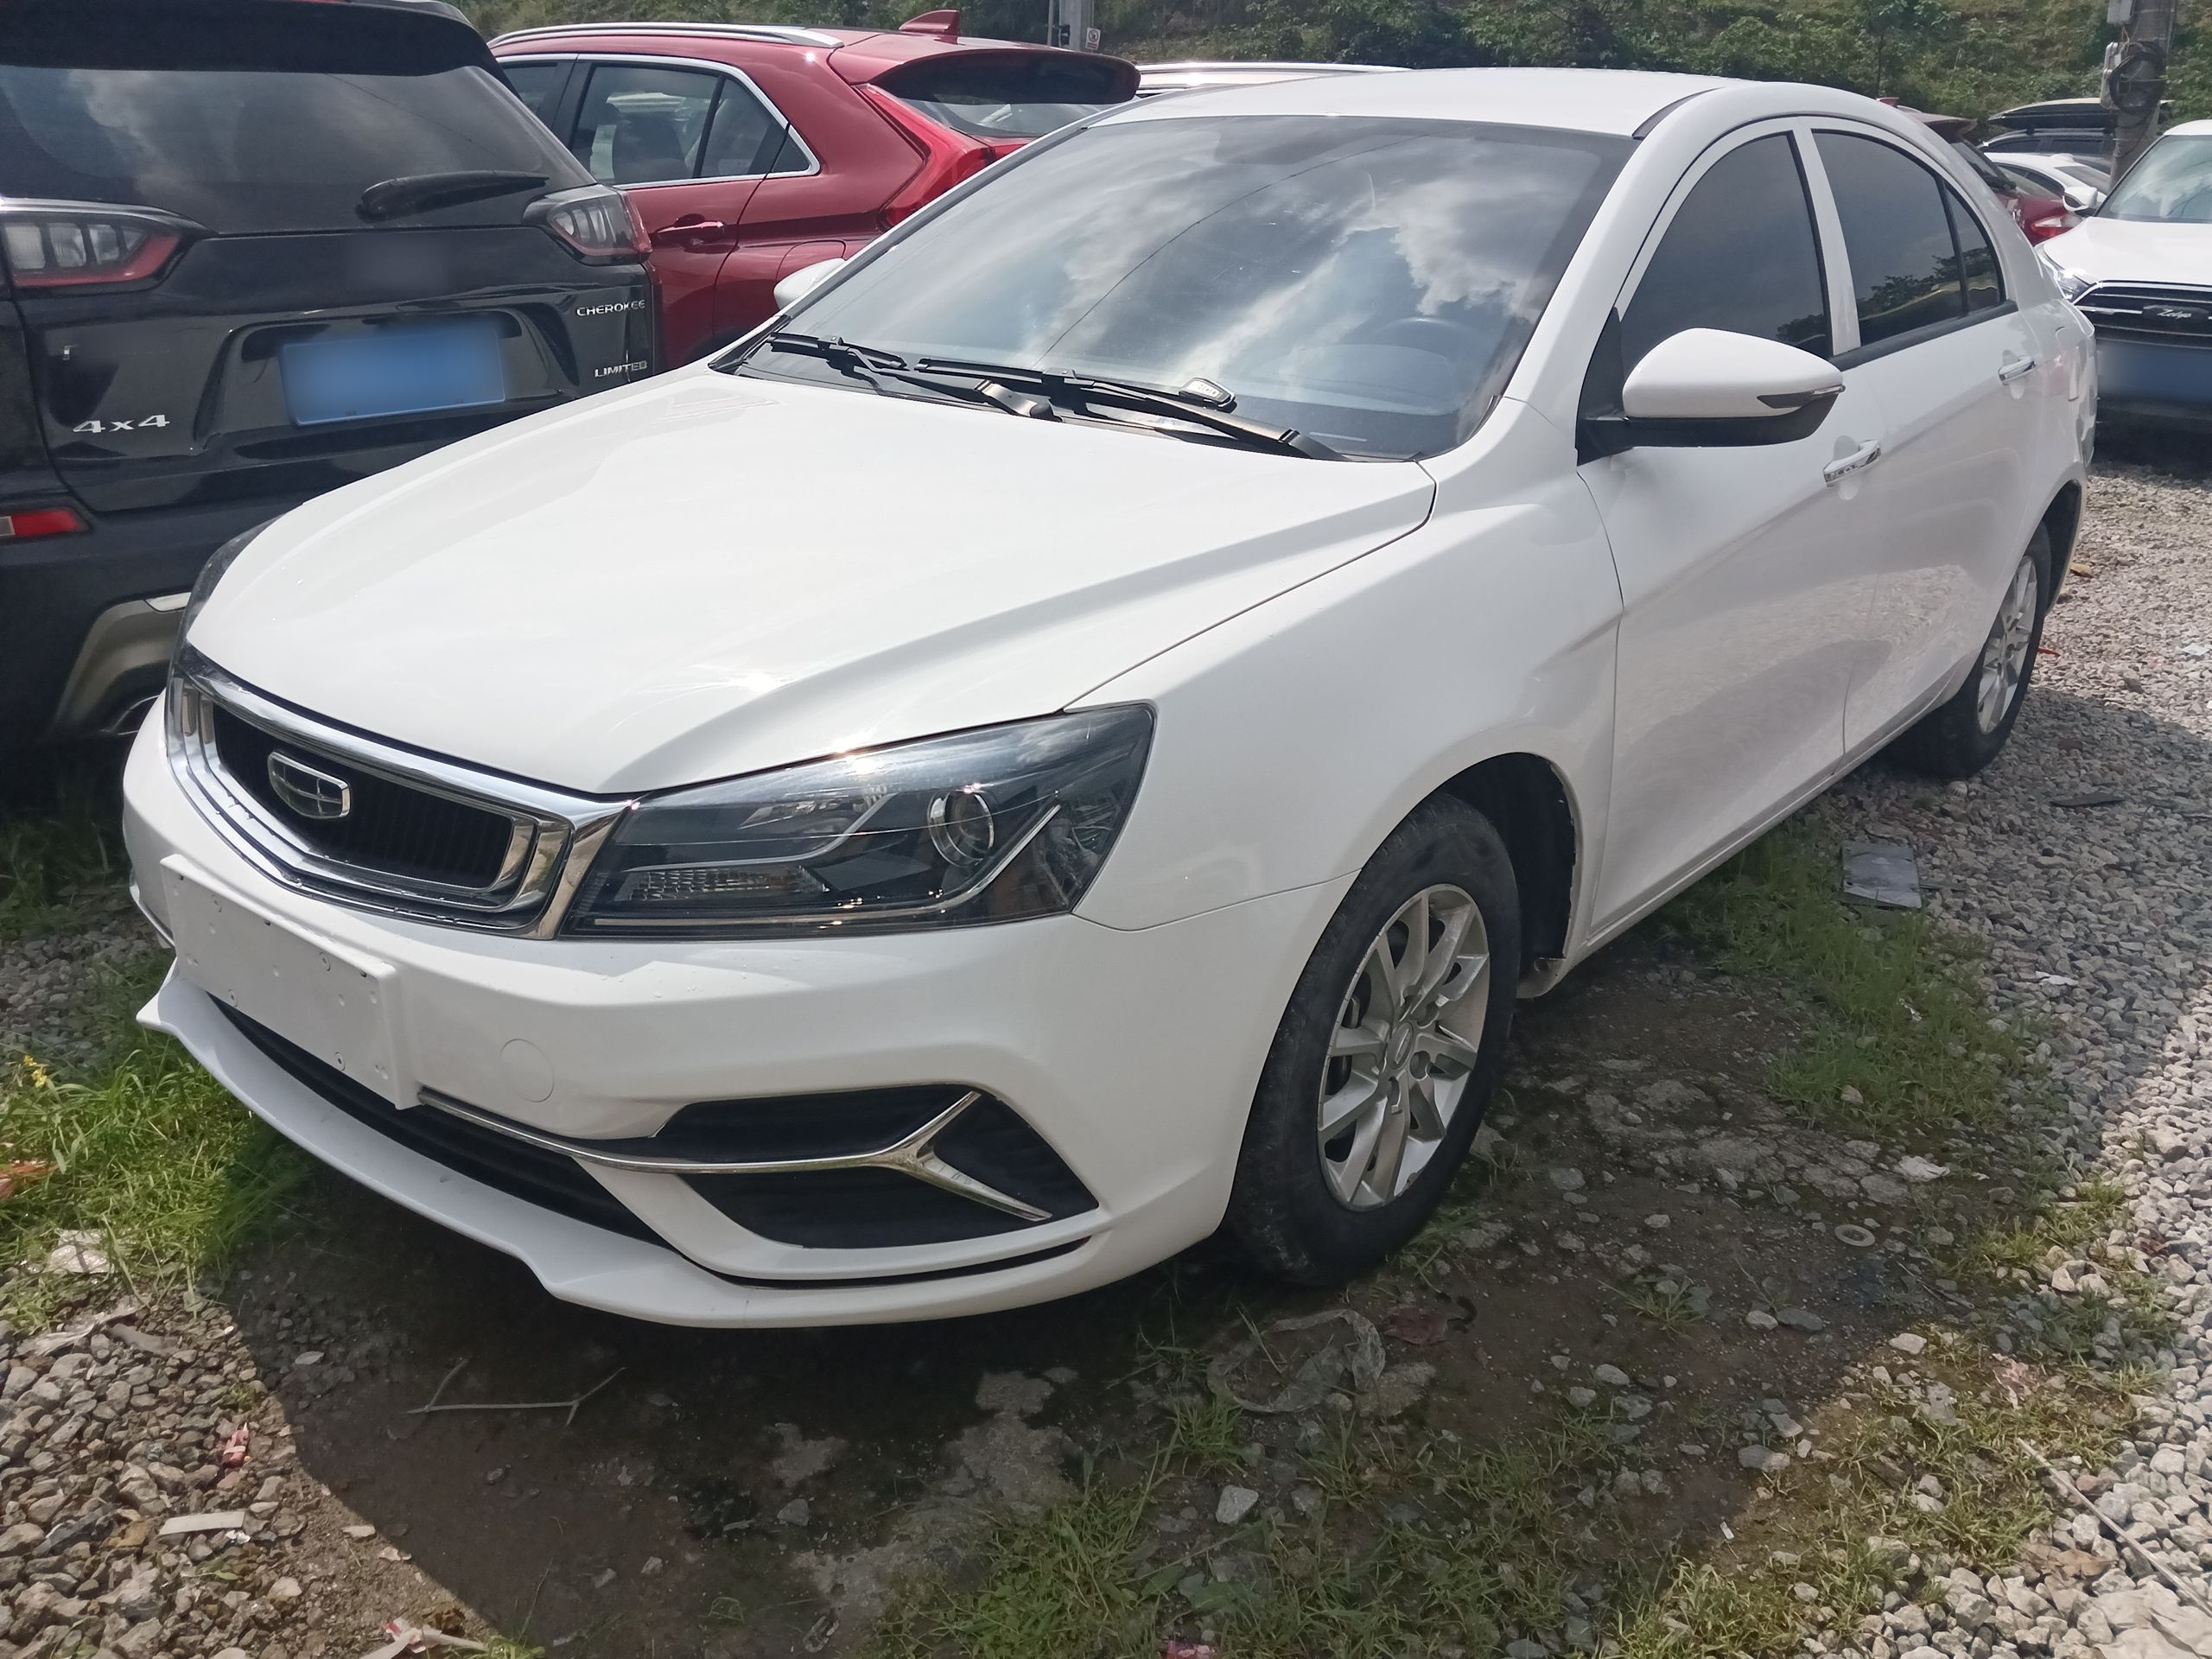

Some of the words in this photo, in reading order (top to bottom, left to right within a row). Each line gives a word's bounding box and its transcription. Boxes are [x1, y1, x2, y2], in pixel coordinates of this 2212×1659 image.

[576, 299, 645, 316] CHEROKEE
[594, 360, 647, 378] LIMITED
[73, 414, 170, 433] 4x4
